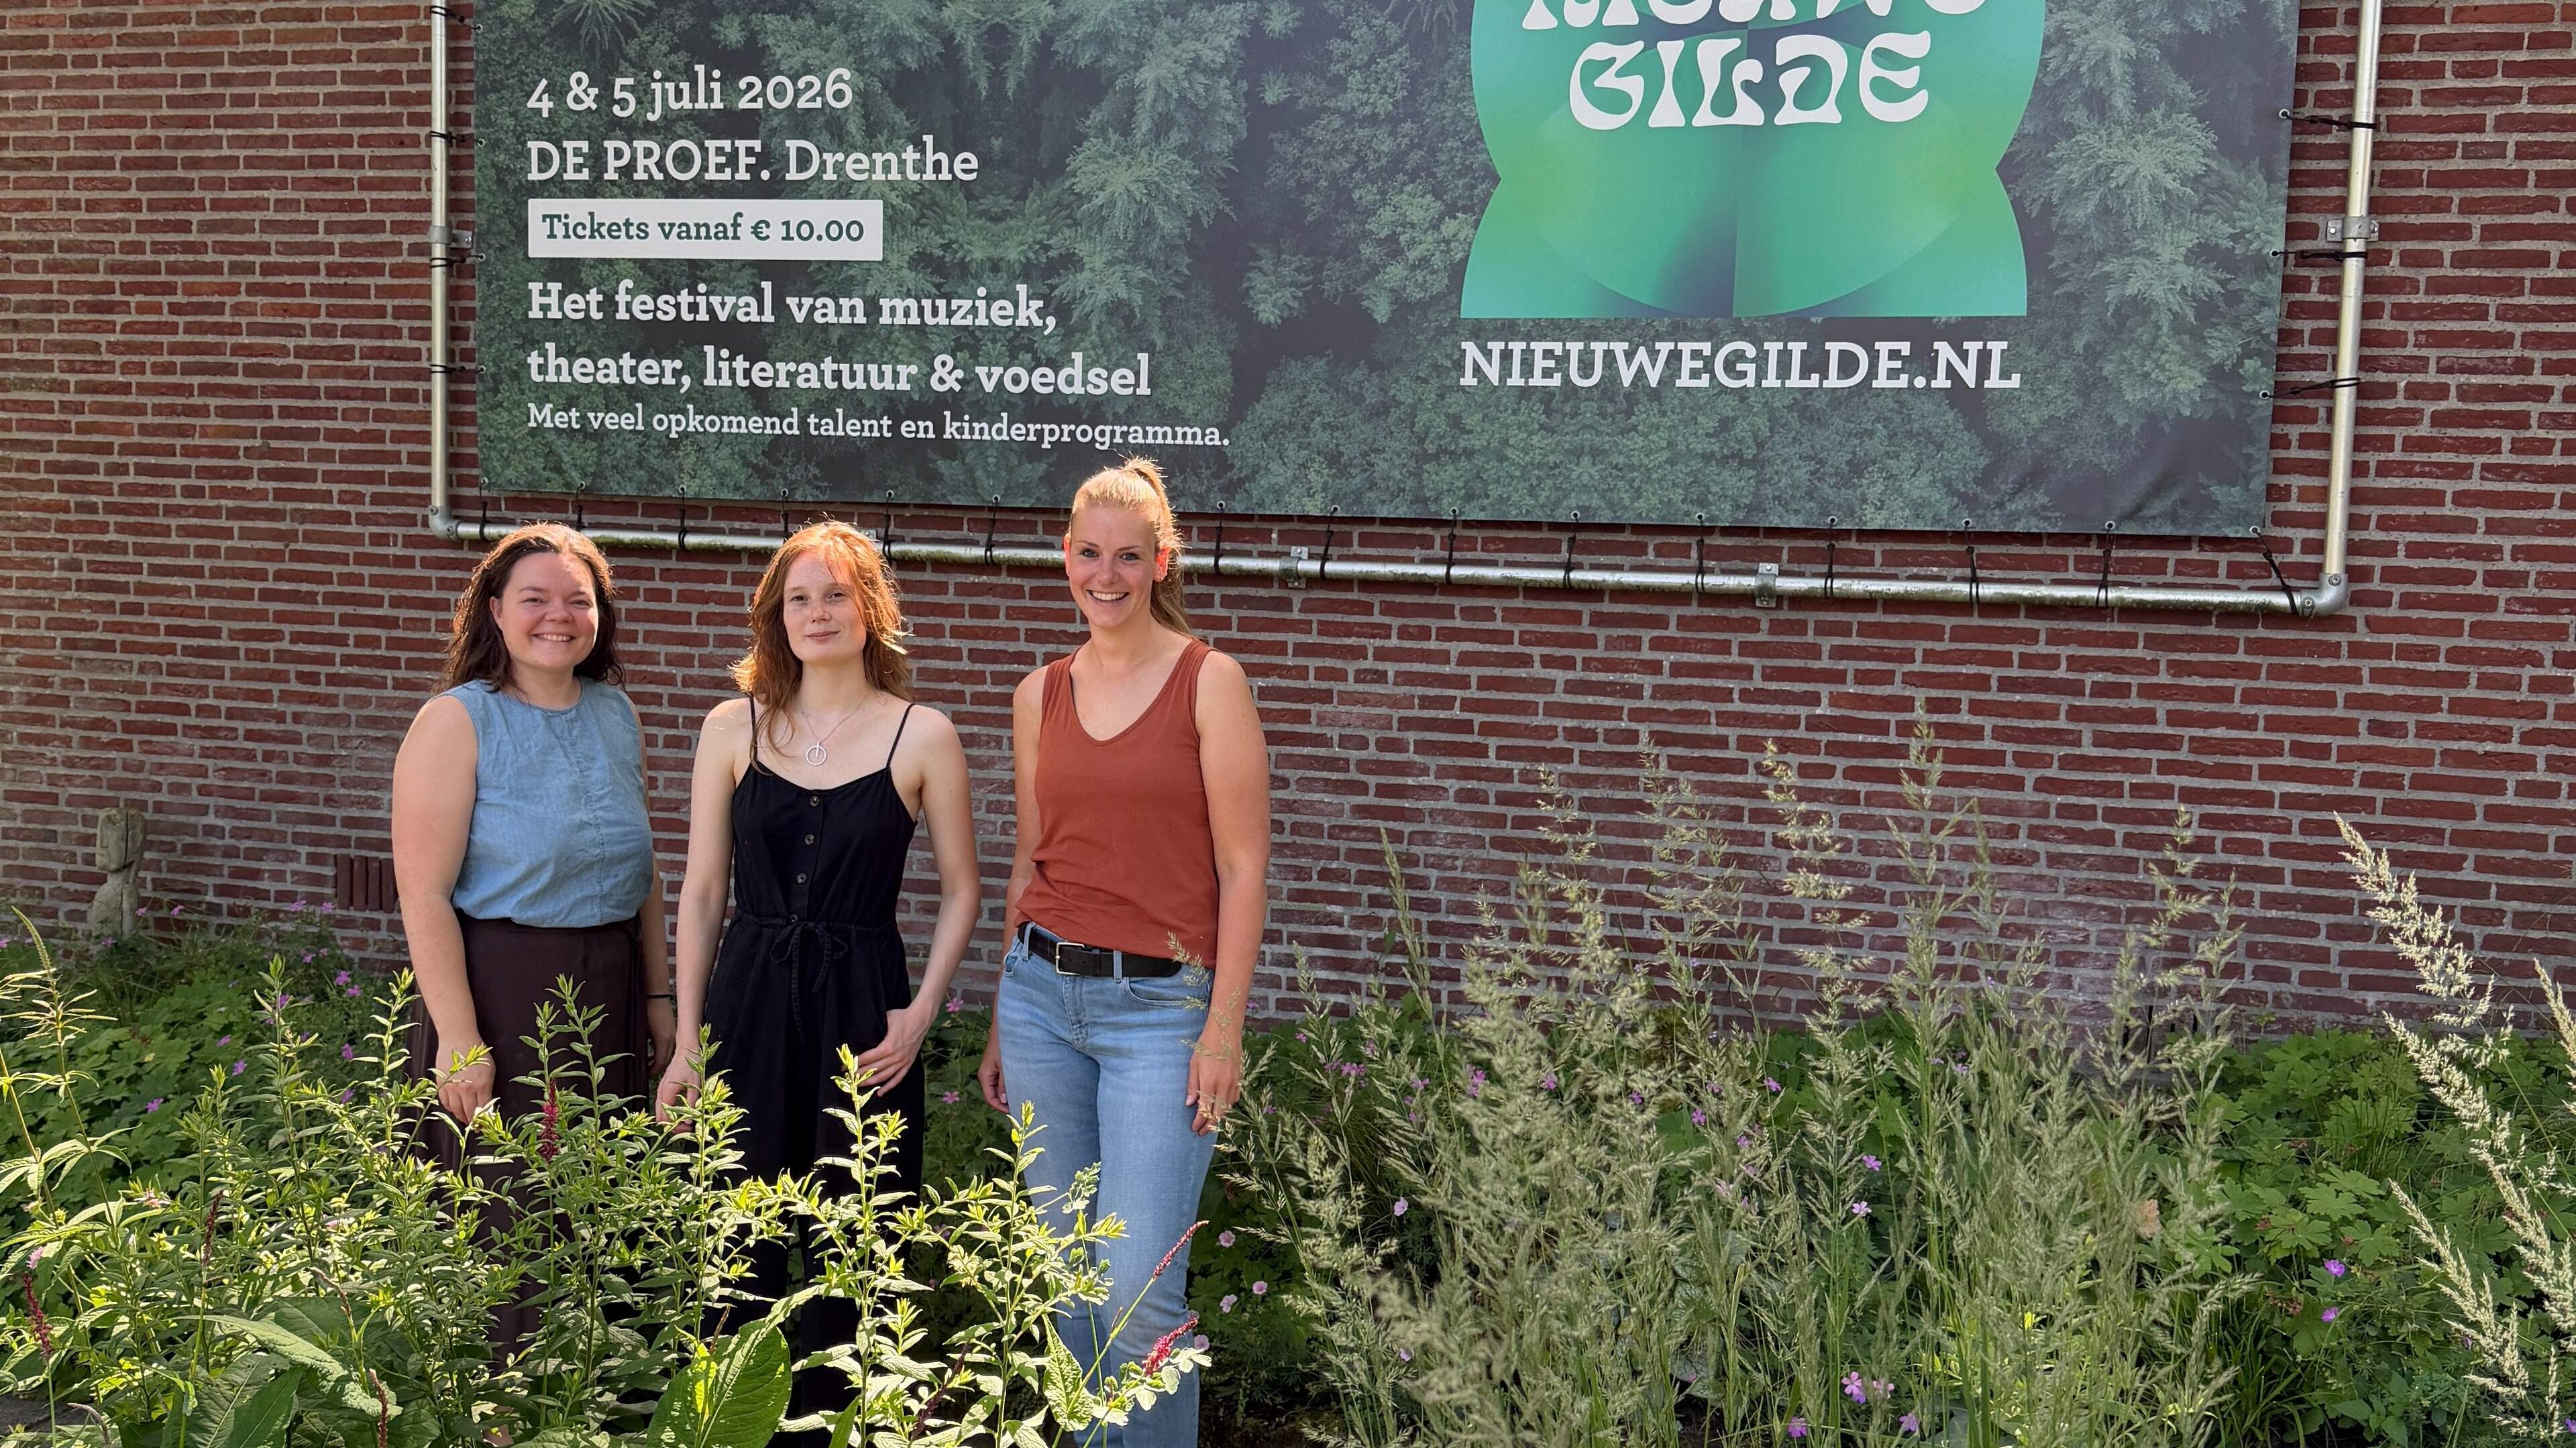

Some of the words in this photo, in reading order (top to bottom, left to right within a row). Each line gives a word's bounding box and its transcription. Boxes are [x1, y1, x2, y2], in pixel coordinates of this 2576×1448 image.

[527, 78, 553, 118] 4
[566, 71, 599, 111] &
[612, 77, 636, 117] 5
[646, 64, 724, 121] juli
[738, 67, 853, 109] 2026
[1569, 30, 1931, 130] GILDE
[527, 140, 590, 180] DE
[603, 139, 770, 181] PROEF.
[785, 134, 979, 181] Drenthe
[541, 211, 649, 240] Tickets
[657, 211, 744, 241] vanaf
[750, 219, 771, 241] €
[781, 219, 864, 242] 10.00
[528, 282, 604, 320] Het
[614, 278, 775, 323] festival
[786, 296, 867, 324] van
[879, 284, 1056, 336] muziek,
[527, 342, 691, 394] theater,
[703, 345, 918, 391] literatuur
[930, 353, 964, 392] &
[975, 351, 1151, 396] voedsel
[1459, 341, 2021, 388] NIEUWEGILDE.NL
[527, 402, 580, 429] Met
[587, 402, 645, 431] veel
[652, 406, 800, 439] opkomend
[807, 408, 892, 437] talent
[900, 420, 936, 439] en
[943, 410, 1230, 450] kinderprogramma.
